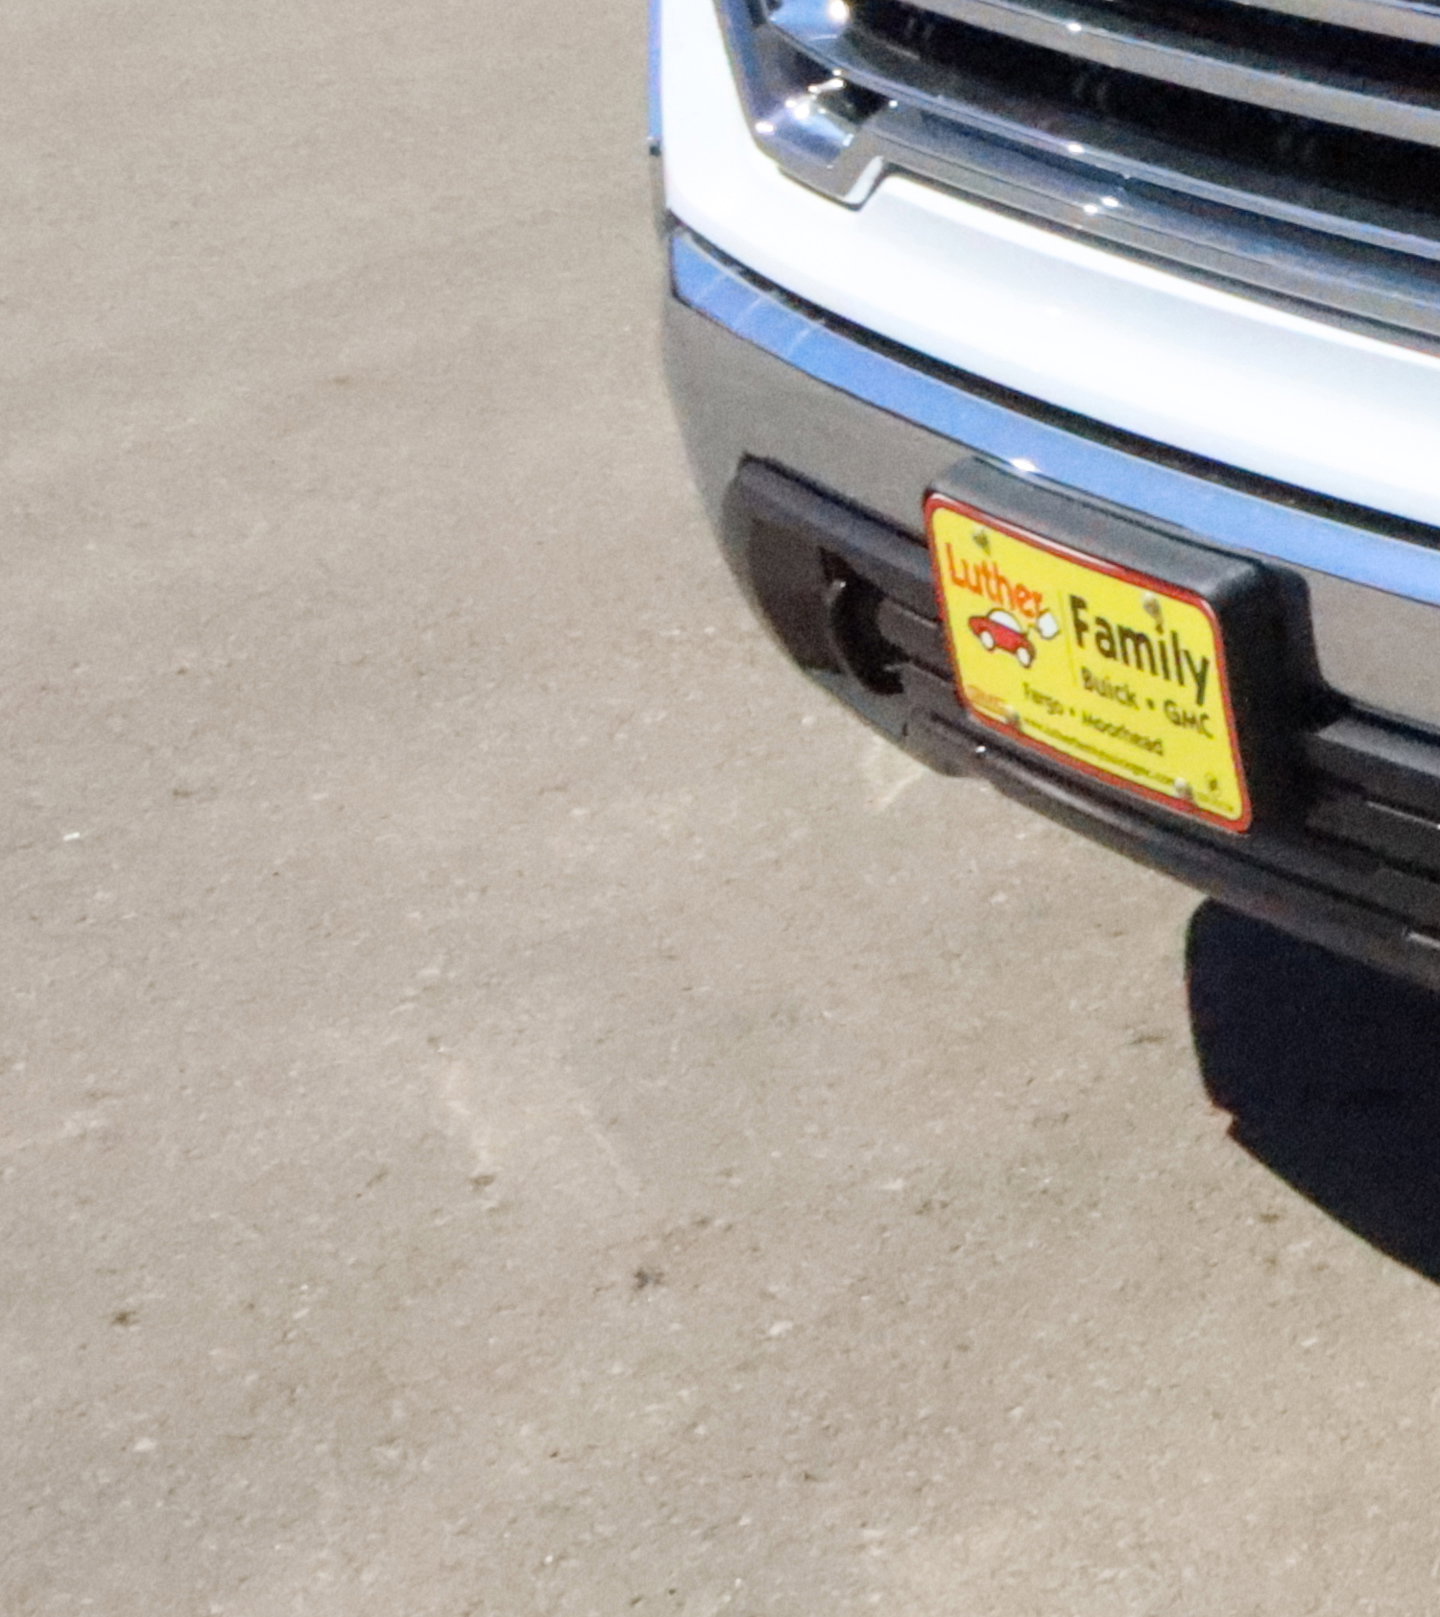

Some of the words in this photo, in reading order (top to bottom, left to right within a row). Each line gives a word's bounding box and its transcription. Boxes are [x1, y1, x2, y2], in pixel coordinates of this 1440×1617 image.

[945, 542, 1044, 619] Luther
[1069, 594, 1210, 706] Family
[1081, 666, 1140, 711] Buick
[1163, 699, 1215, 740] GMC
